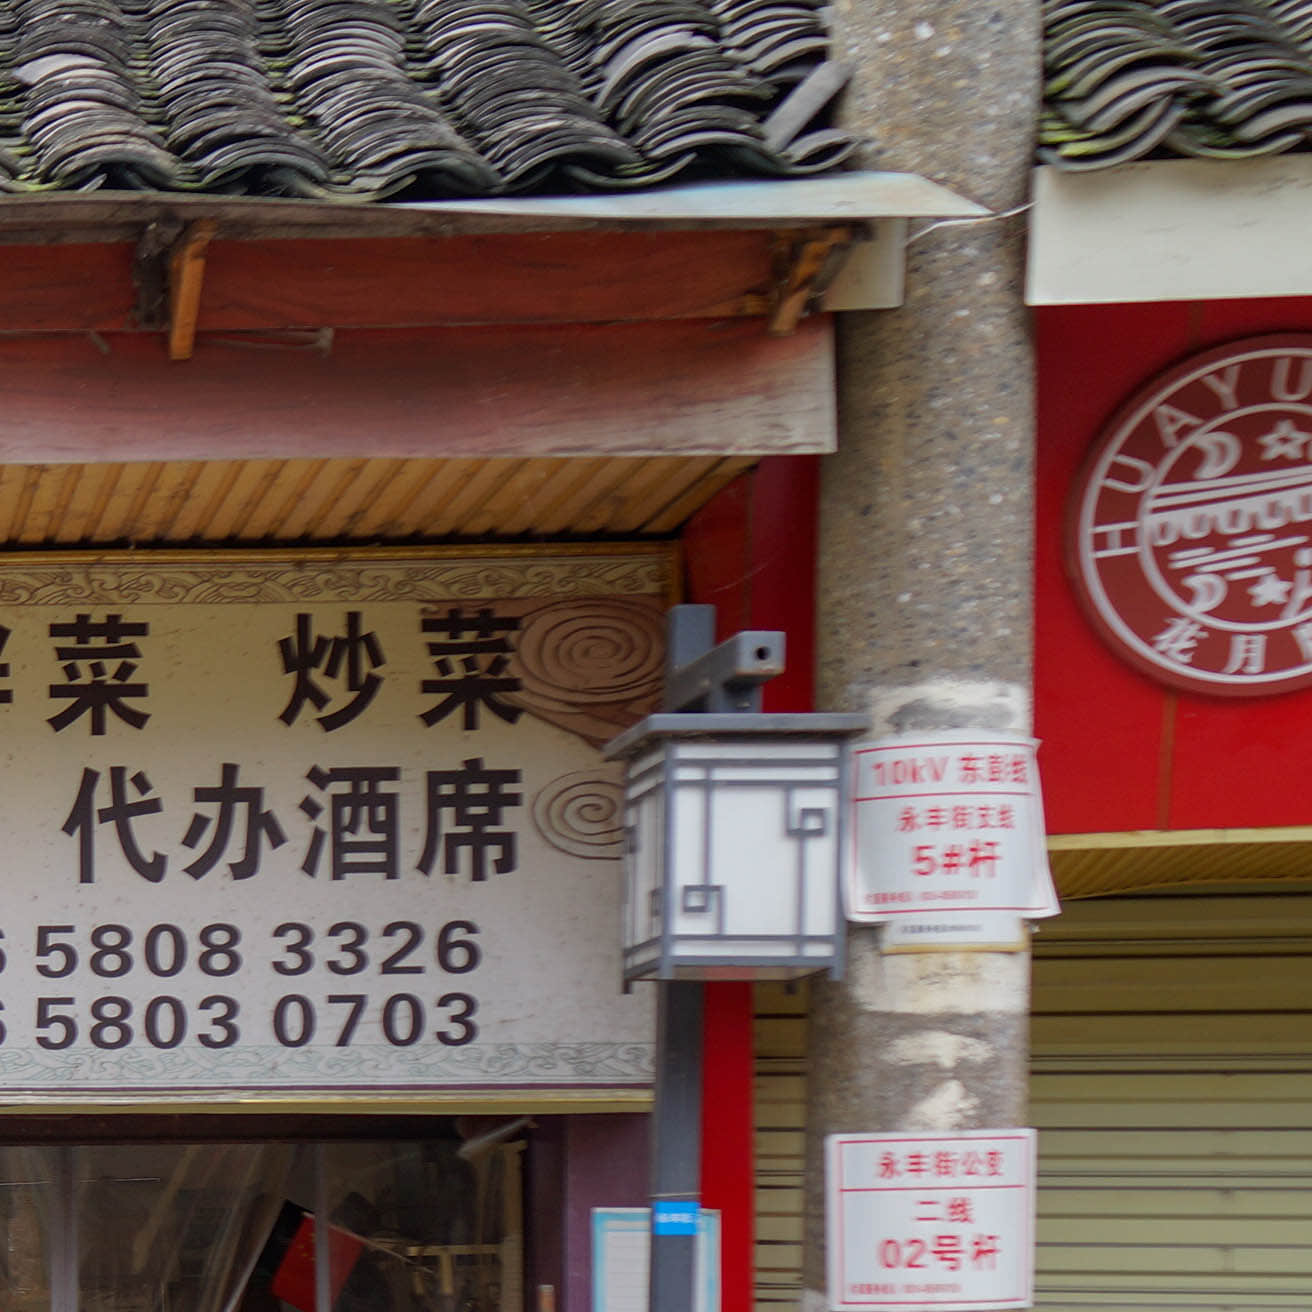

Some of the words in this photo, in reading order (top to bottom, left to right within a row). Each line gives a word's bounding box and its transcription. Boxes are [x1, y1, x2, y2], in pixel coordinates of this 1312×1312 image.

[280, 609, 525, 732] 炒菜
[62, 758, 523, 883] 代办酒席
[35, 922, 243, 979] 5808
[271, 920, 483, 976] 3326
[35, 995, 243, 1050] 5803
[271, 993, 481, 1048] 0703
[913, 1198, 974, 1224] 二线
[879, 1234, 1001, 1271] 02号杆
